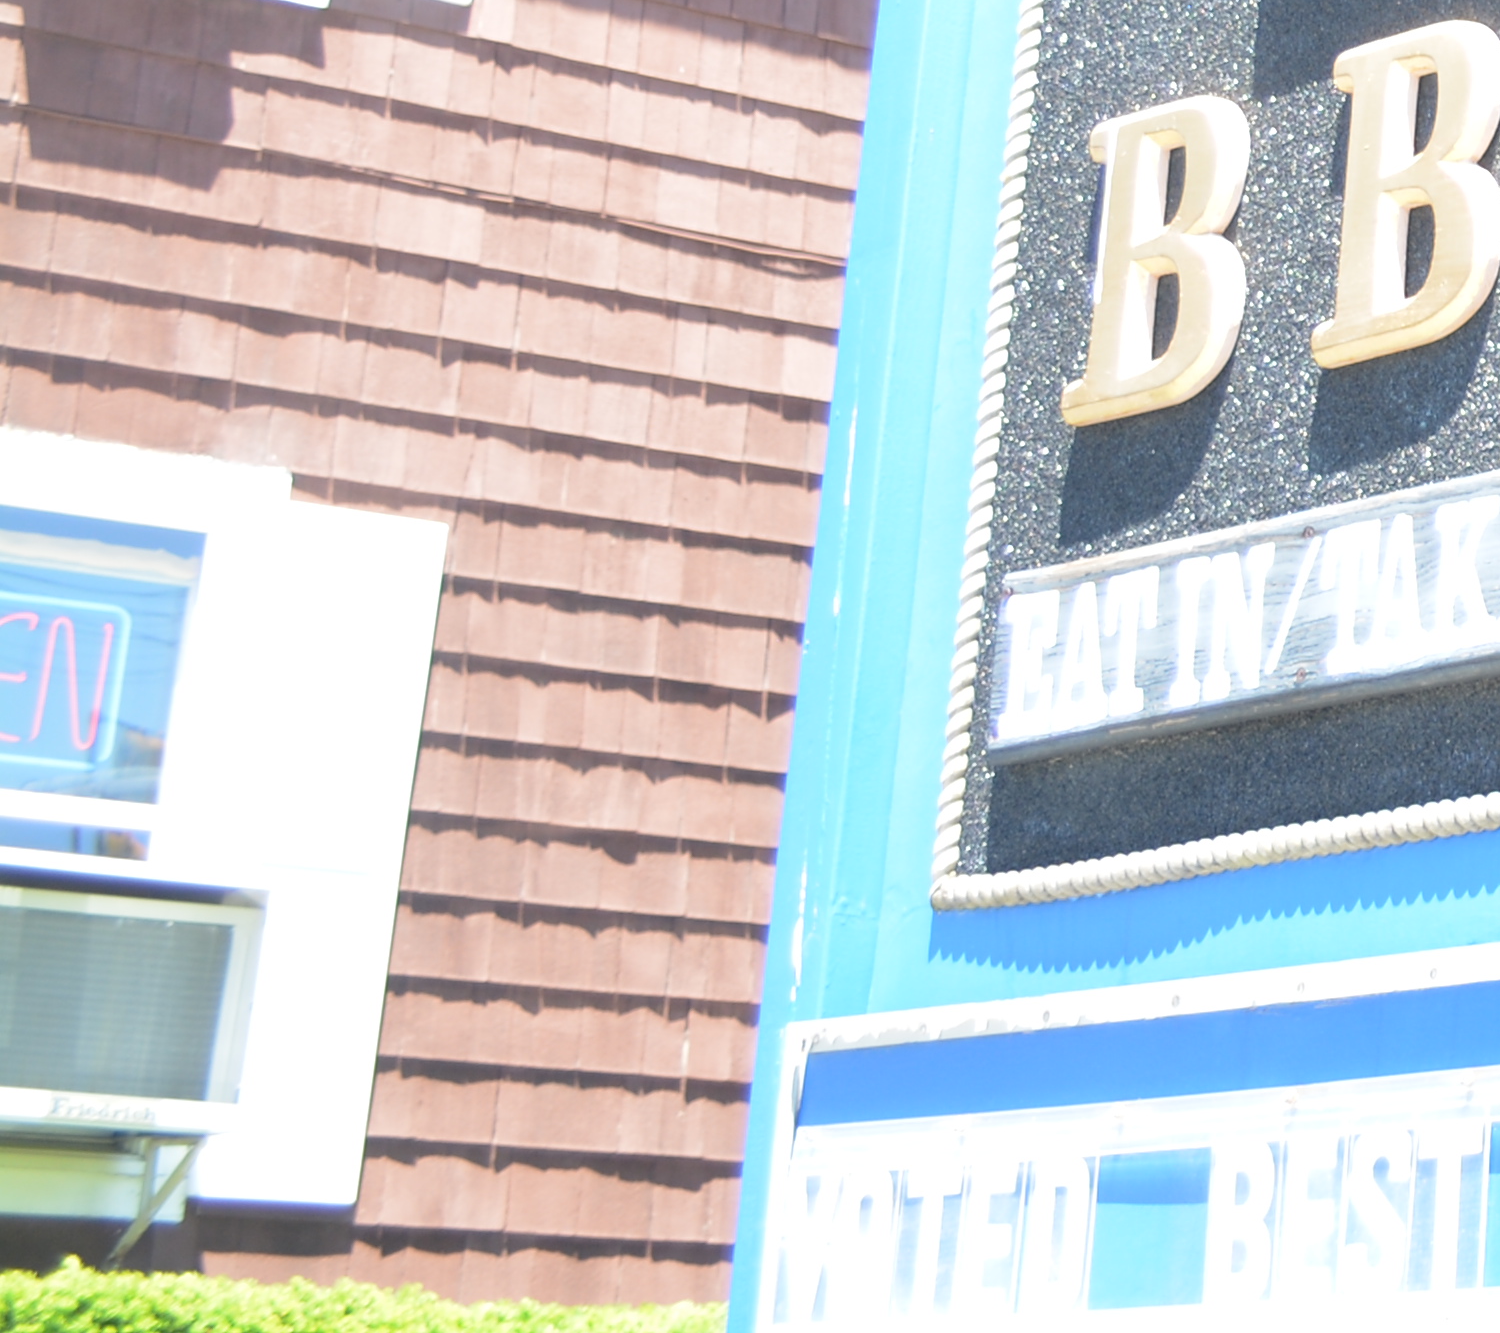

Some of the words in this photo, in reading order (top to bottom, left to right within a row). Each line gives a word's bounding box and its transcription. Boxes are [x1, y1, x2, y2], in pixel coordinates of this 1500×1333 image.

[997, 566, 1160, 738] EAT
[51, 1096, 156, 1122] Friedrich
[774, 1153, 1092, 1325] VOTED
[1208, 1119, 1487, 1307] BEST
